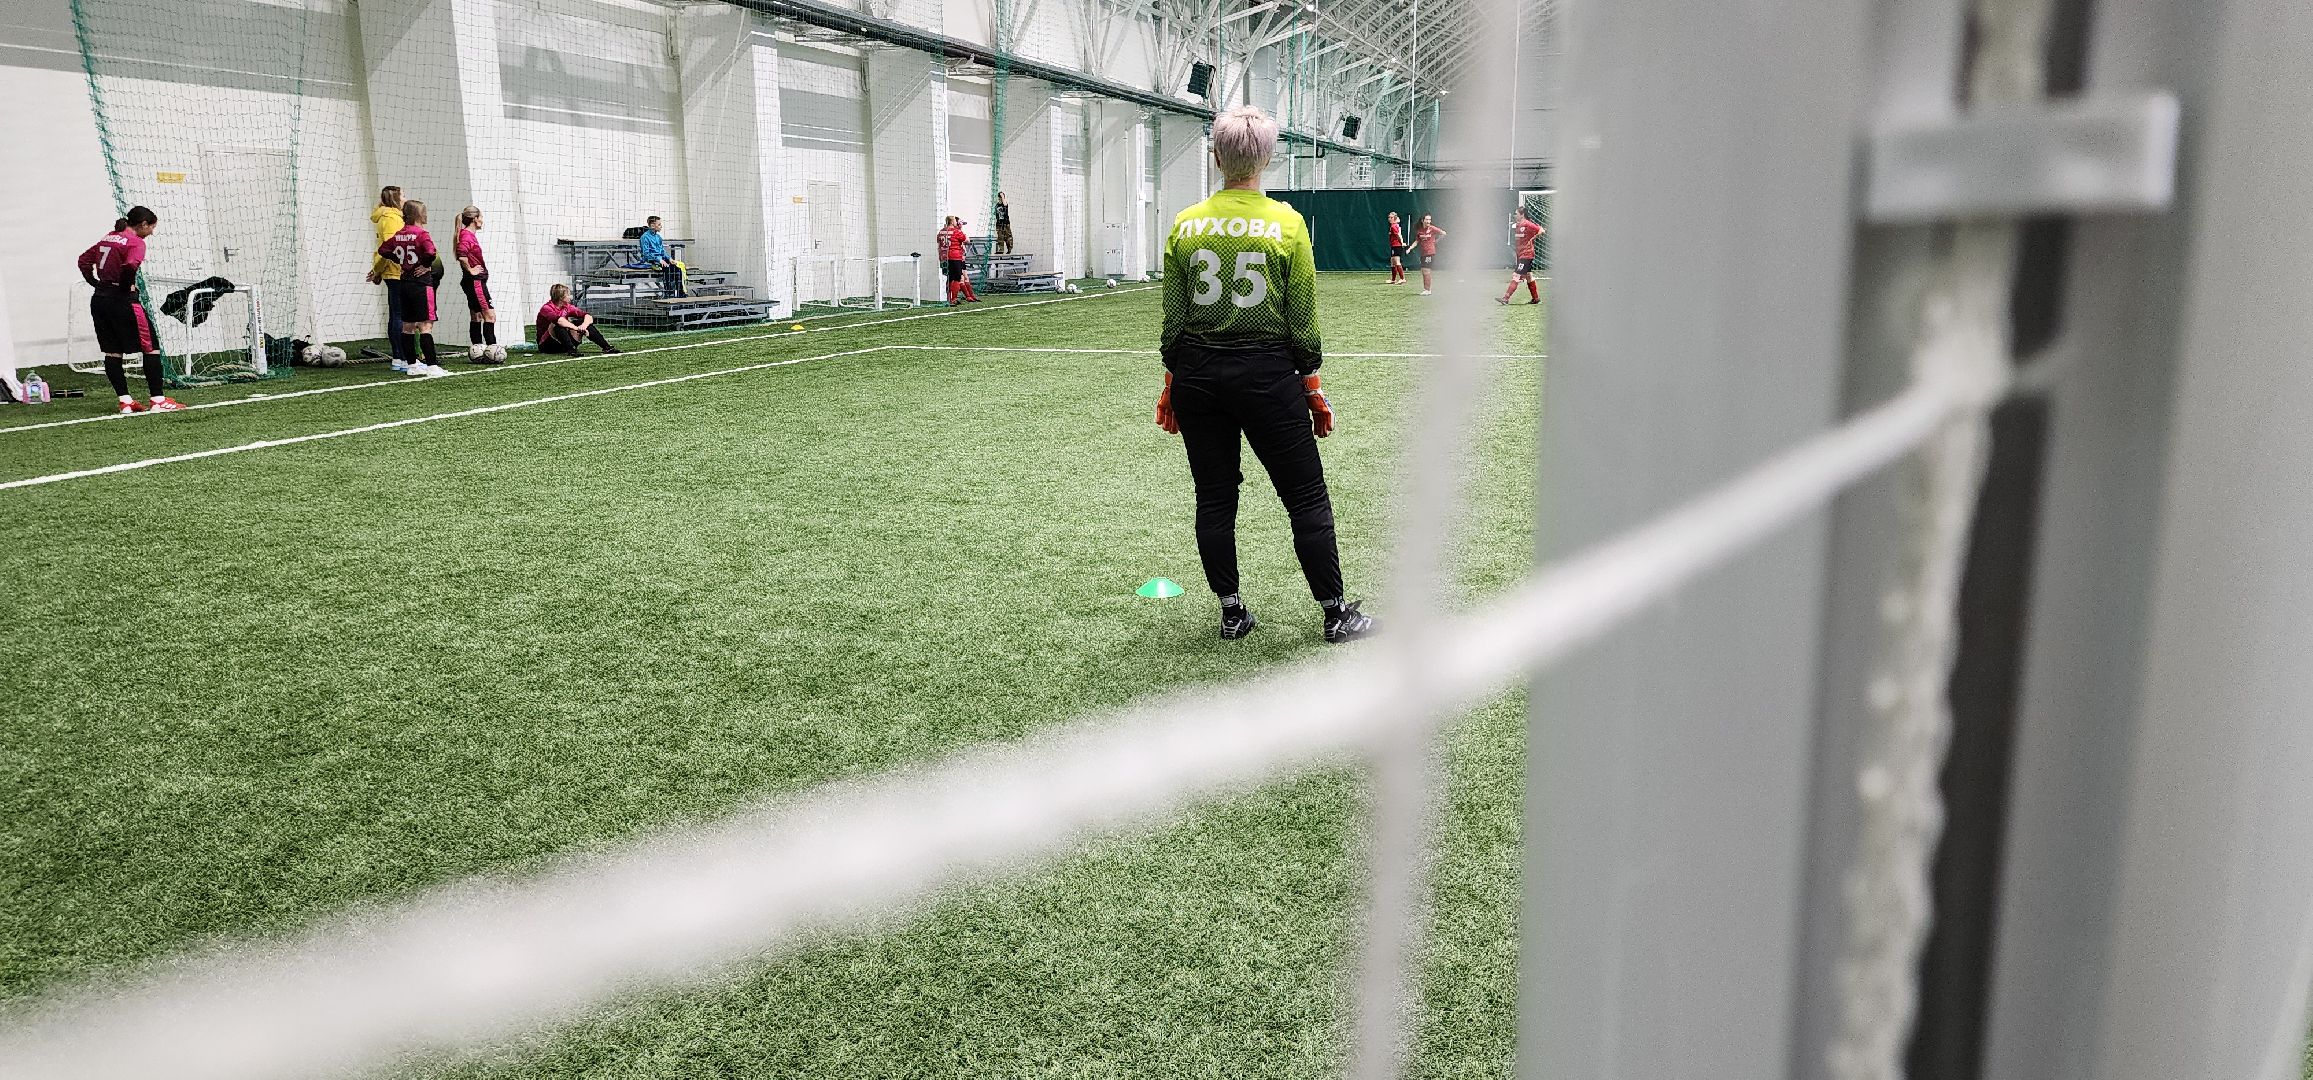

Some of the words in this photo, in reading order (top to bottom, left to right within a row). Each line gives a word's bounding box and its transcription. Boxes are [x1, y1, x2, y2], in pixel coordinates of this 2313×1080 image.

[100, 246, 111, 269] 7
[393, 245, 418, 265] 95
[1189, 248, 1267, 309] 35
